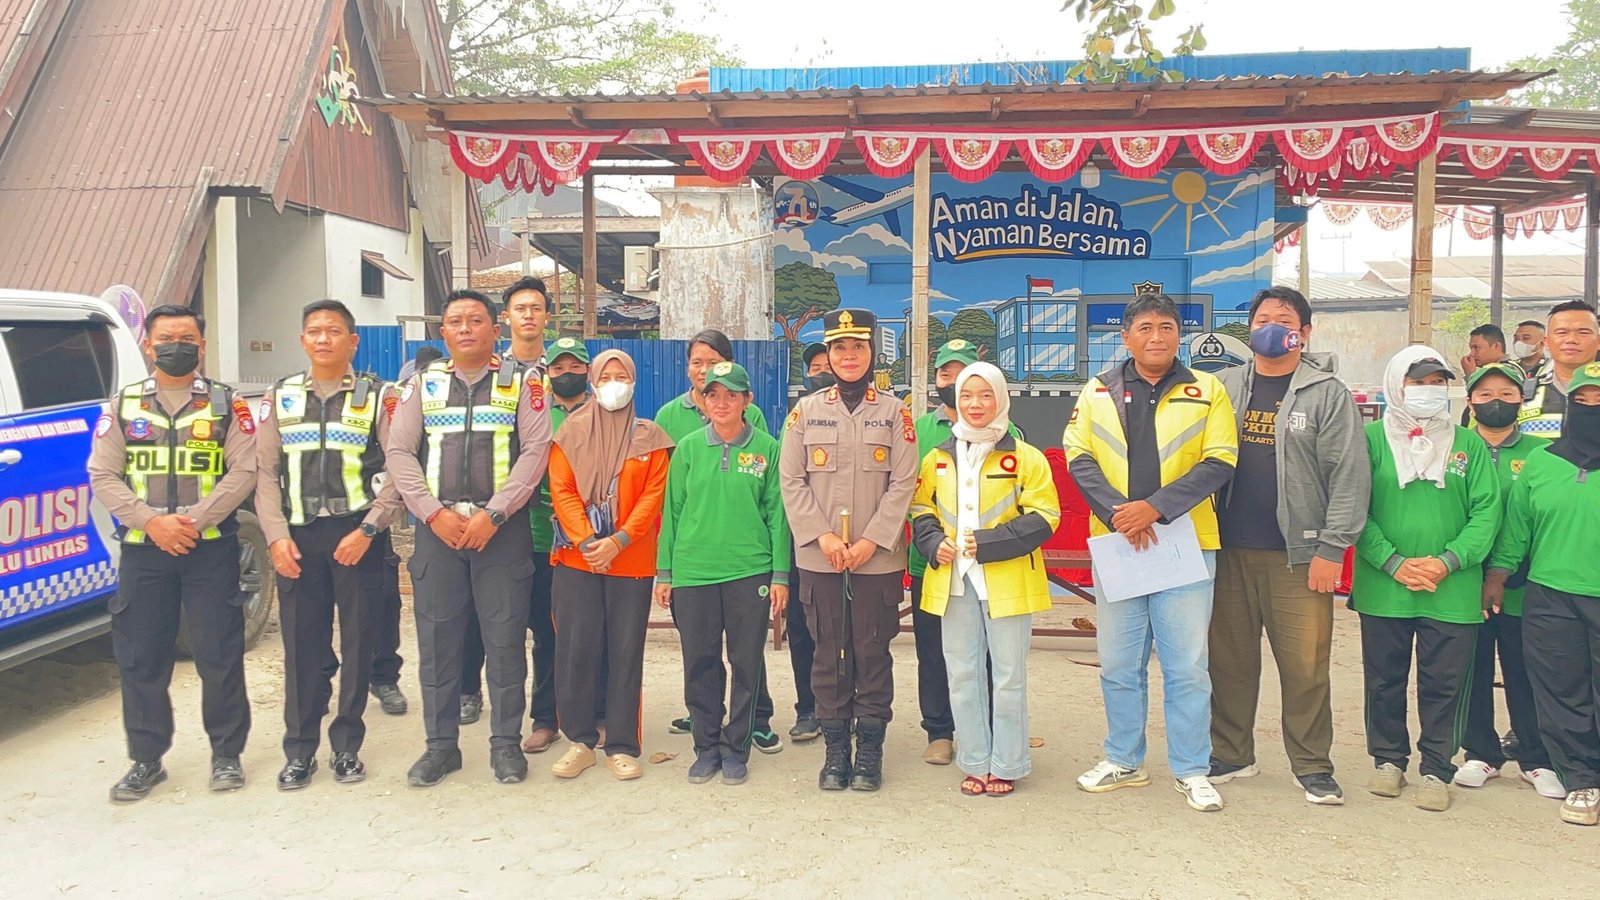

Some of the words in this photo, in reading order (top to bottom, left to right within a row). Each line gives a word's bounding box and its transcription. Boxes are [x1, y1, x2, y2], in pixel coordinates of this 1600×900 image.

[932, 197, 1009, 228] Aman
[1014, 190, 1036, 217] di
[1040, 193, 1119, 231] Jalan,
[934, 223, 1034, 258] Nyaman
[1038, 224, 1147, 256] Bersama
[864, 419, 893, 428] POLRI
[127, 450, 221, 471] POLISI
[25, 535, 88, 567] LINTAS
